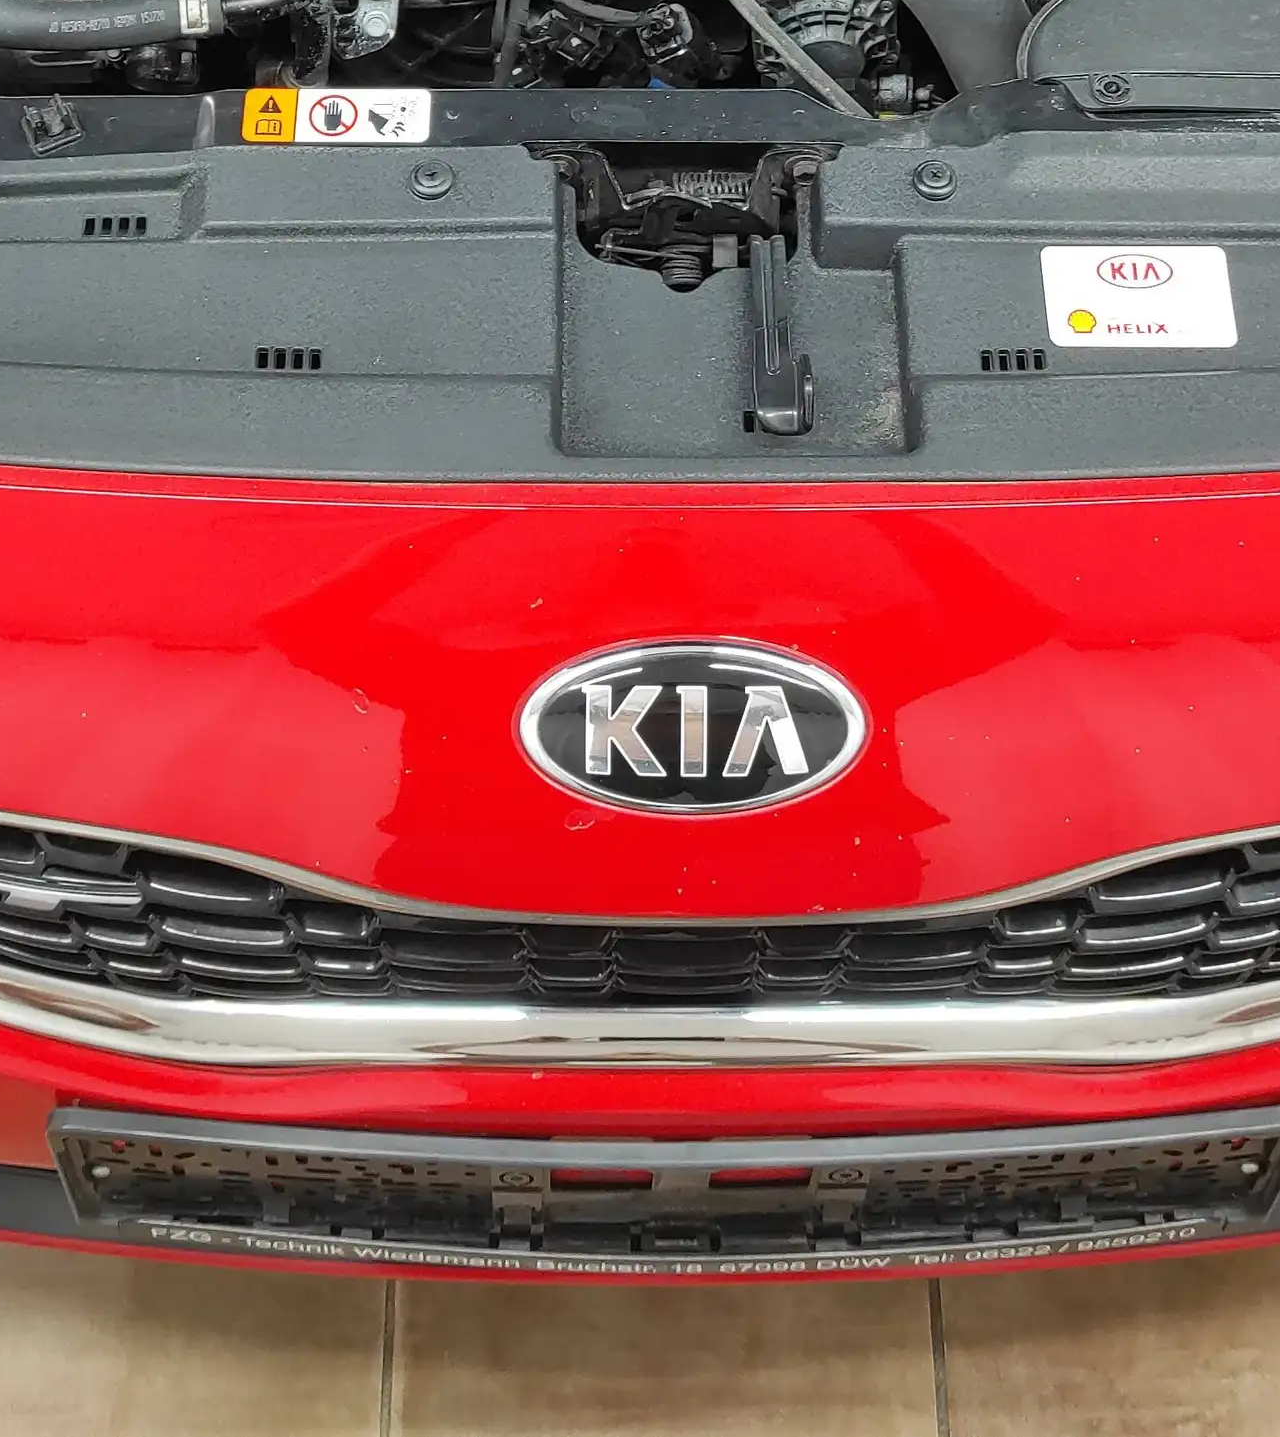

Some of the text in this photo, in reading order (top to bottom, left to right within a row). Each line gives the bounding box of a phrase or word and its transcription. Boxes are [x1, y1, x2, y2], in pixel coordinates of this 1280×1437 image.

[1109, 262, 1161, 281] KIA
[1107, 321, 1169, 334] HELIX
[582, 685, 809, 777] KIA
[238, 1234, 345, 1257] Technik
[353, 1246, 520, 1269] Wiedemann
